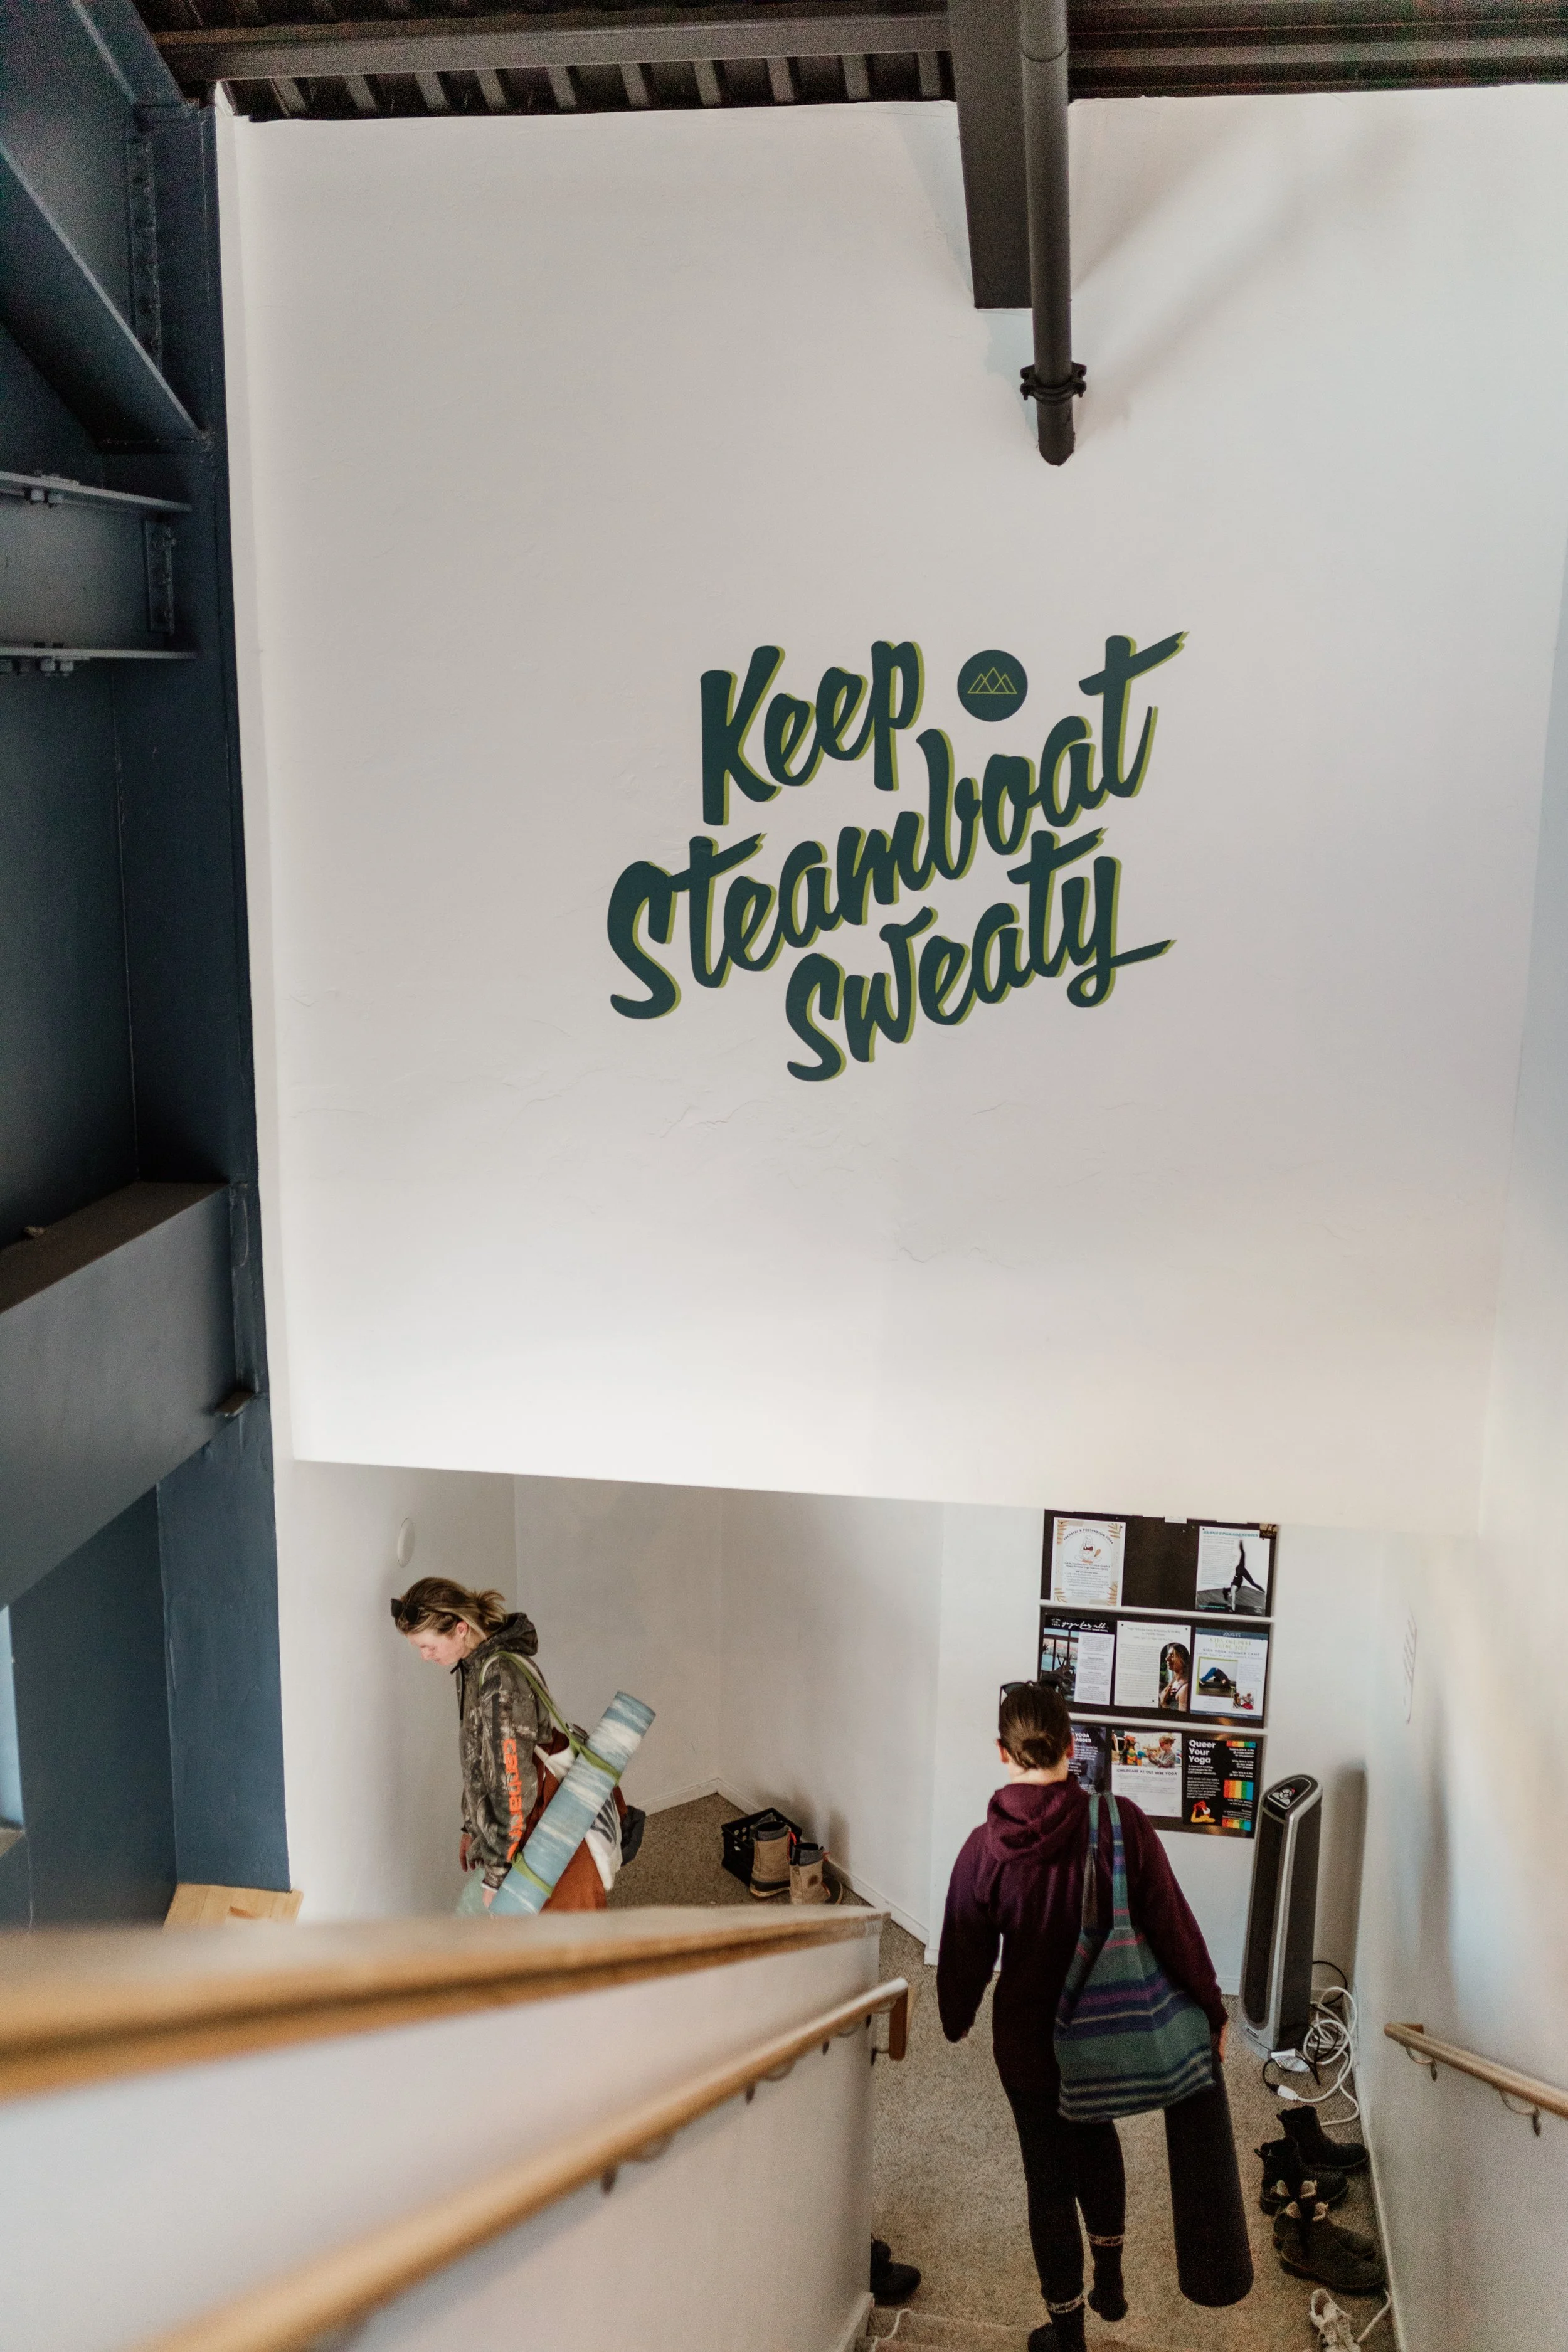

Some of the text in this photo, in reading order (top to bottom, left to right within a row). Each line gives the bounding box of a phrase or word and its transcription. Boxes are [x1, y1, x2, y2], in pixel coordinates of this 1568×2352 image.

[701, 640, 924, 826] Keep
[607, 630, 1190, 1020] Steamboat
[785, 827, 1177, 1082] Sweaty
[1063, 1530, 1079, 1540] PRENATAL
[1083, 1528, 1106, 1537] POSTPARTUM
[1061, 1621, 1079, 1629] yoga
[1189, 1740, 1216, 1749] Queer
[1189, 1747, 1210, 1756] Your
[1189, 1756, 1211, 1765] Yoga
